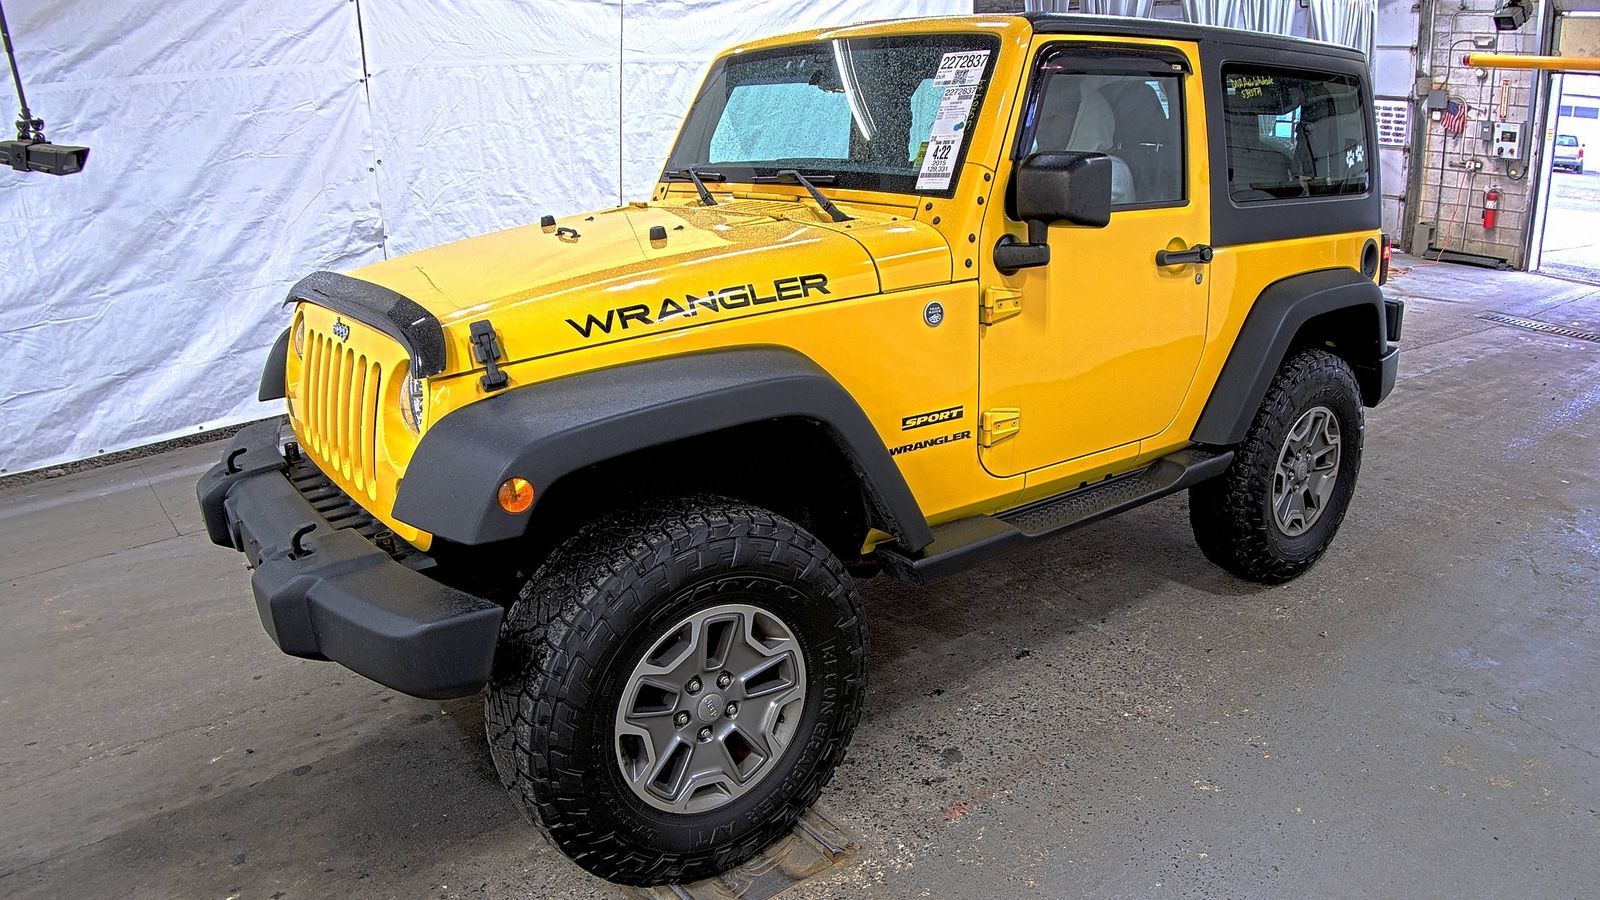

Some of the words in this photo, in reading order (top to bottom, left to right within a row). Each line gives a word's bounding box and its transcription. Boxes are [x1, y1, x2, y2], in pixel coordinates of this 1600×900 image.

[941, 54, 989, 70] 2272837
[945, 87, 977, 97] 2272837
[932, 145, 952, 160] 4:22
[565, 274, 832, 339] WRANGLER
[904, 408, 963, 427] SPORT
[889, 431, 972, 456] WRANGLER
[704, 698, 717, 717] Jeep
